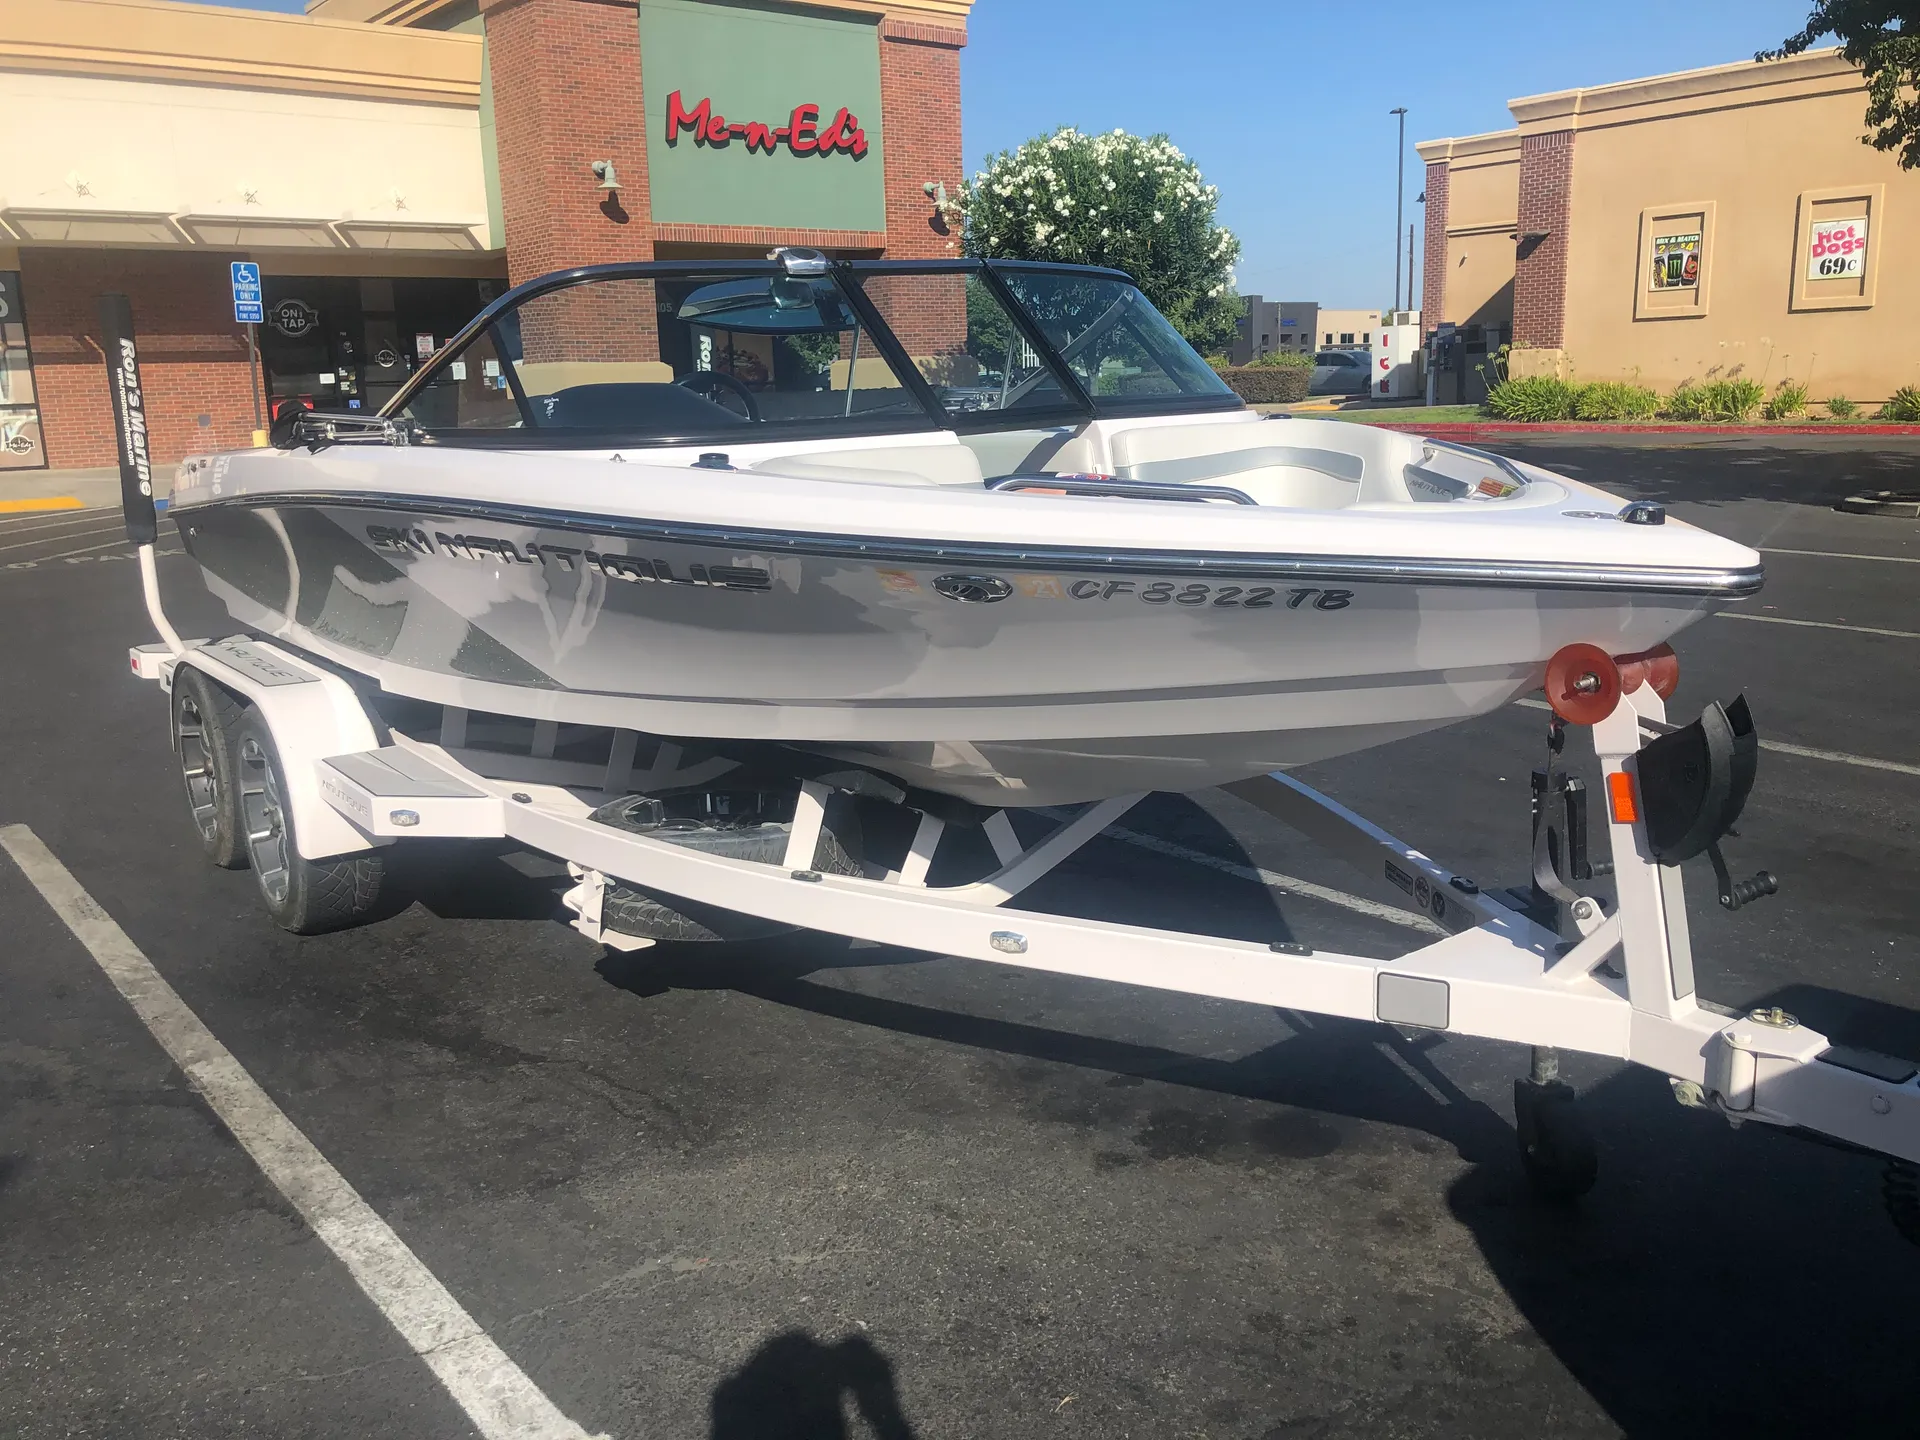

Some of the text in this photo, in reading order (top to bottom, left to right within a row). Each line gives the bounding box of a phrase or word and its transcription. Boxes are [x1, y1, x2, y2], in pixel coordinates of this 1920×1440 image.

[666, 89, 868, 157] Me-n-Ed's
[1817, 225, 1855, 244] Hot
[1658, 245, 1666, 254] 2
[1812, 237, 1865, 258] Dogs
[234, 282, 258, 292] PARKING
[240, 292, 255, 300] ONLY
[281, 309, 298, 318] ON
[281, 318, 306, 328] TAP
[119, 337, 152, 497] Ron's Marine
[1409, 480, 1450, 496] NAUTIQUE
[366, 524, 772, 593] SKI NAUTIQUE
[1066, 580, 1355, 611] CF 8822 TB
[322, 779, 368, 816] NAUTIQUE
